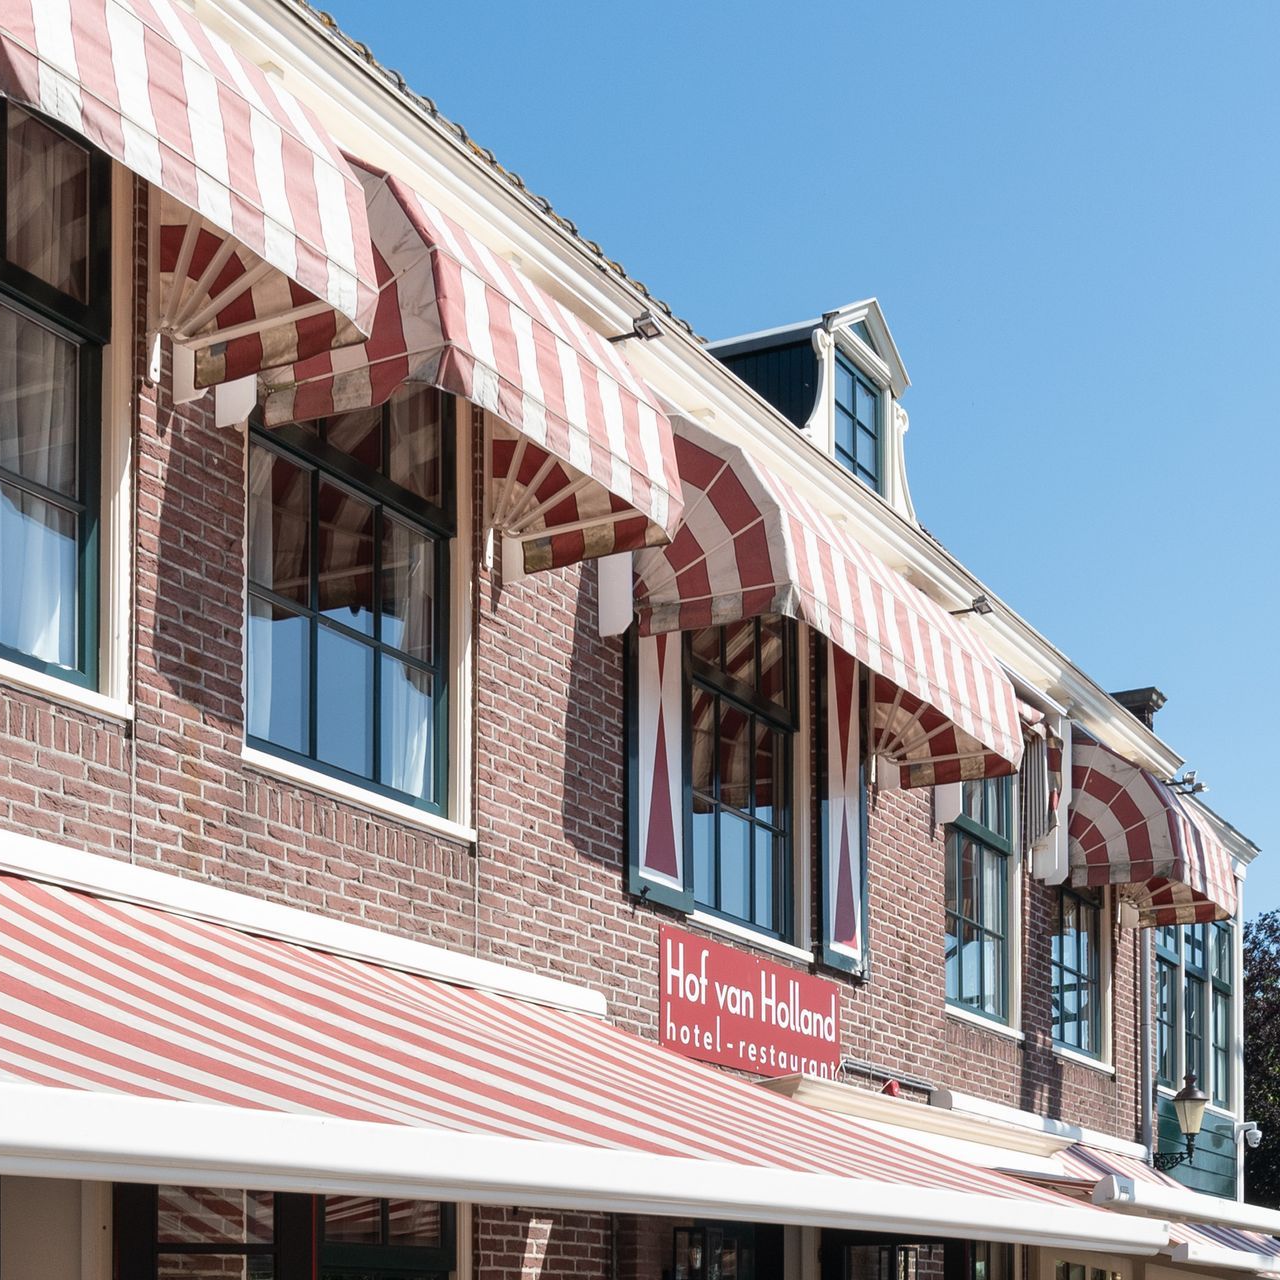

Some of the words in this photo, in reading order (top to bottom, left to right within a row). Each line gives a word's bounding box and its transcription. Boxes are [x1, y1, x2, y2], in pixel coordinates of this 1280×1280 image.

[666, 938, 709, 1005] Hof
[714, 981, 754, 1019] van
[760, 970, 836, 1043] Holland
